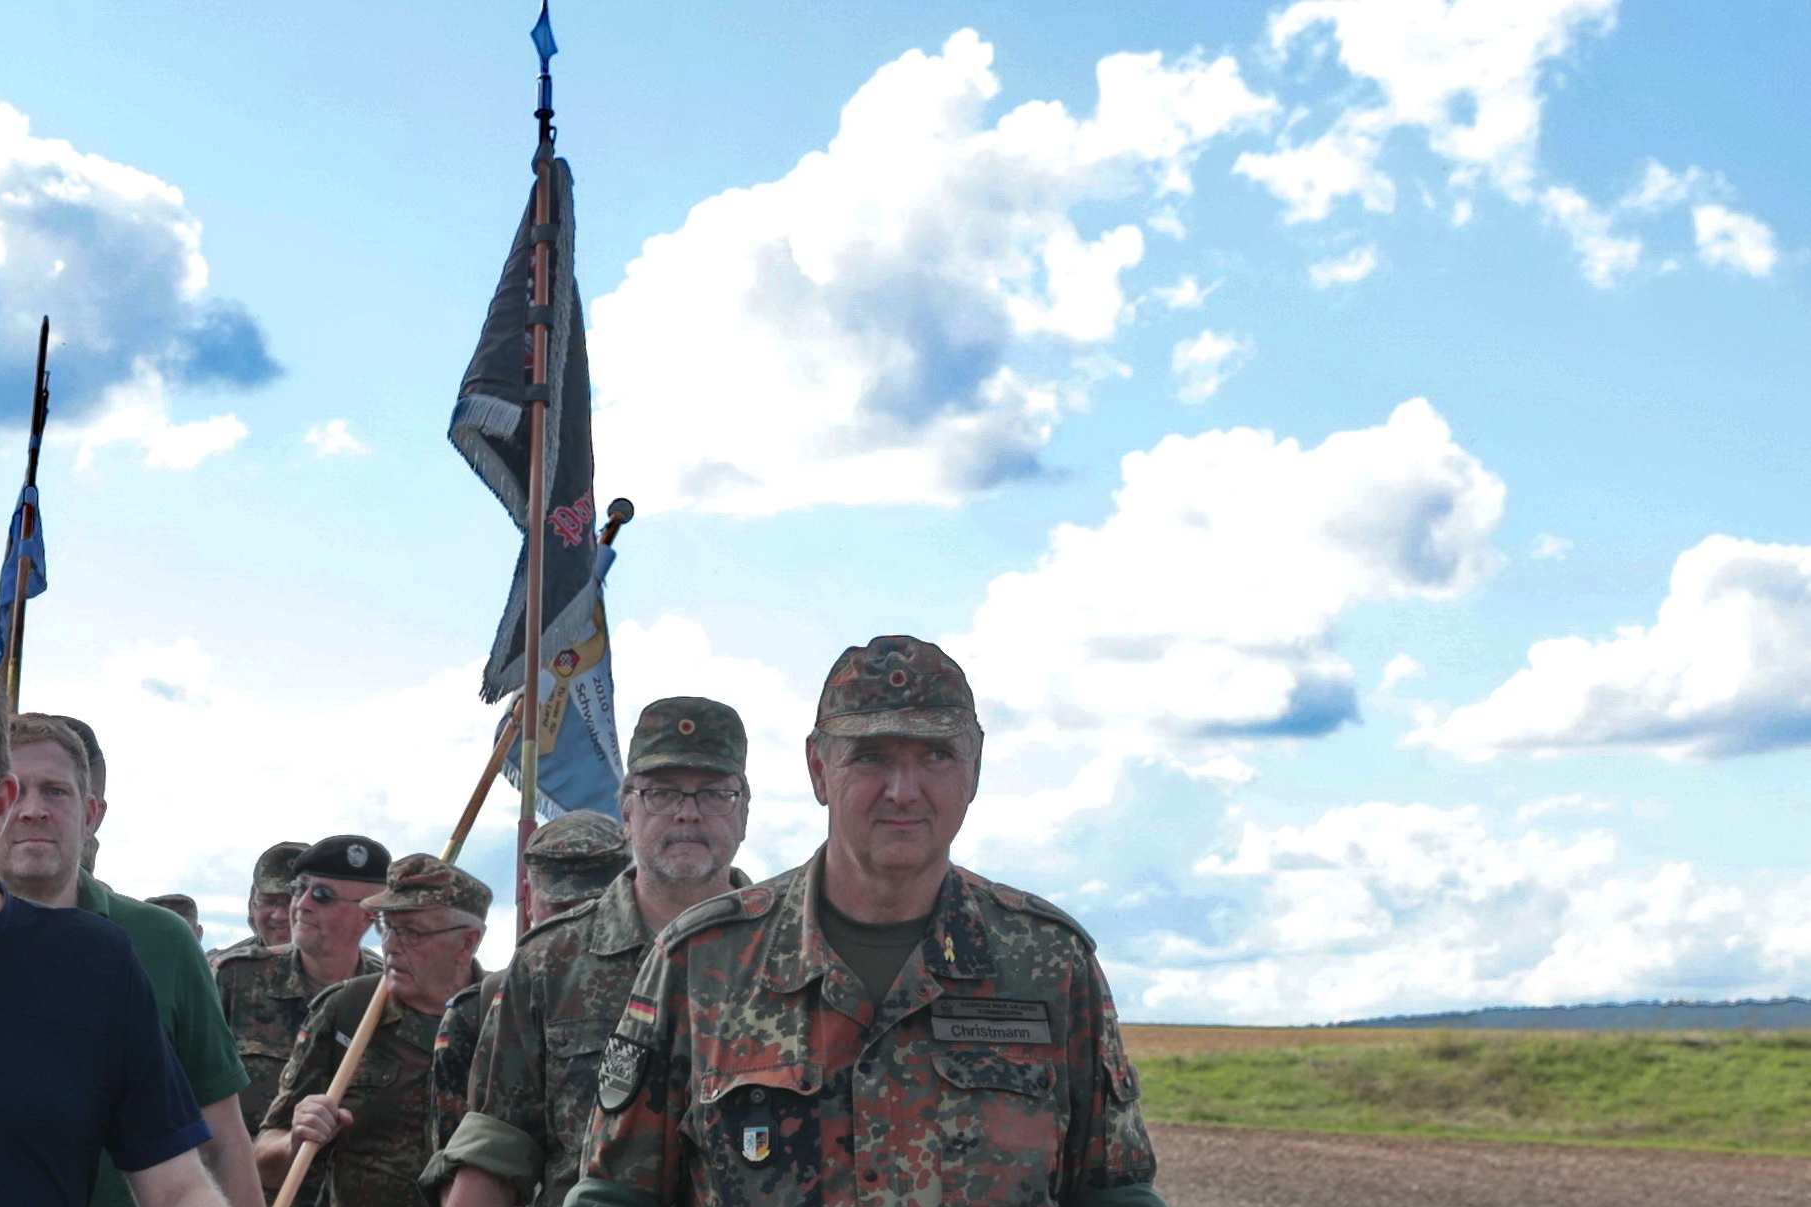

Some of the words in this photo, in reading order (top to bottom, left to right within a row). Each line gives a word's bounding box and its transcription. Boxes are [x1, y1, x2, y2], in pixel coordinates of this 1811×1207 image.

[592, 675, 610, 713] 2010
[575, 682, 607, 763] Schwaben
[951, 1023, 1031, 1039] Christmann
